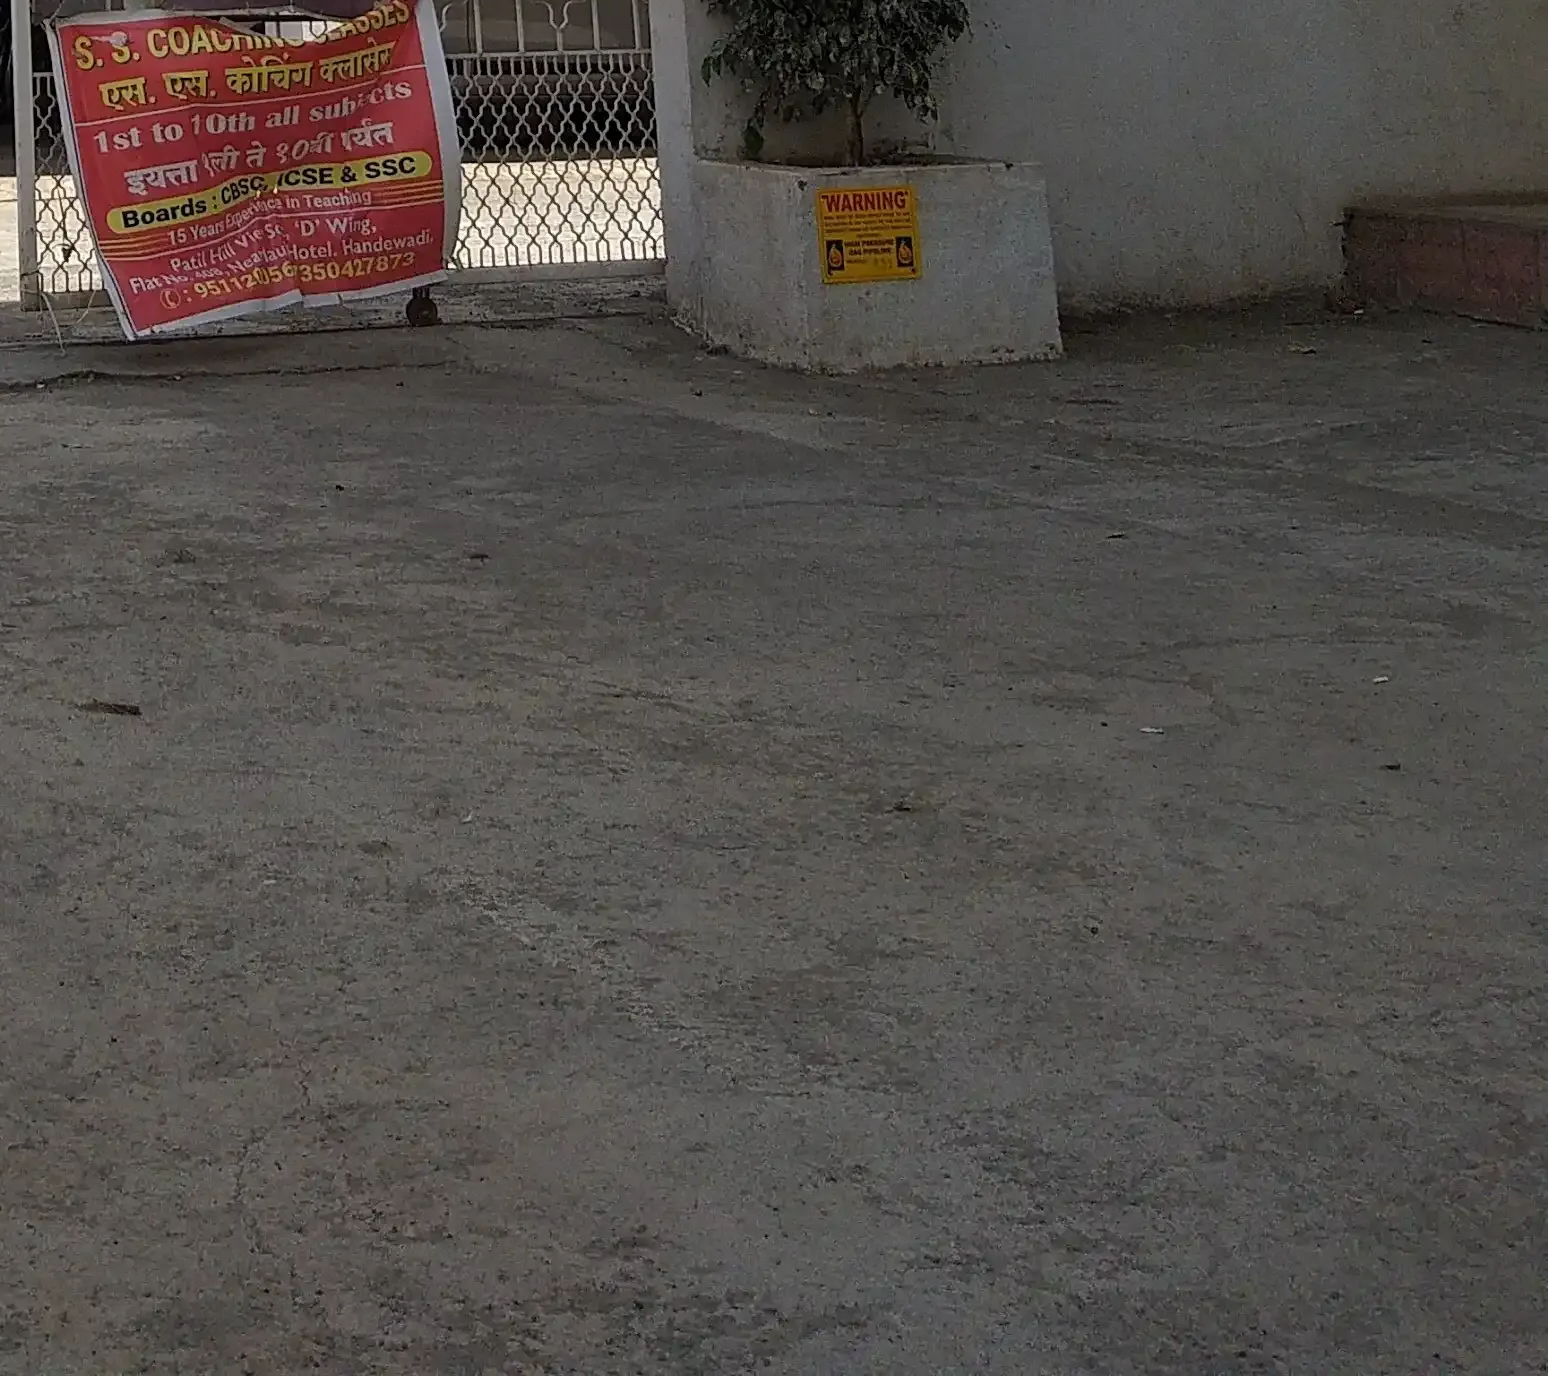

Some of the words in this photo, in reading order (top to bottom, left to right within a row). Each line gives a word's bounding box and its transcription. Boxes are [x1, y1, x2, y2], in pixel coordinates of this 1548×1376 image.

[73, 34, 104, 70] S.
[98, 76, 157, 111] एस.
[162, 69, 217, 100] एस.
[224, 51, 314, 95] कोचिंग
[93, 127, 144, 153] 1st
[152, 121, 184, 143] to
[190, 111, 256, 135] 10th
[265, 106, 300, 128] all
[121, 198, 207, 229] Boards
[278, 167, 334, 187] ICSE
[340, 166, 357, 183] &
[364, 156, 416, 179] SSC
[123, 159, 198, 196] इयत्ता
[245, 140, 267, 169] ते
[167, 230, 187, 246] 15
[305, 189, 373, 209] Teaching
[170, 249, 207, 273] Patil
[210, 241, 237, 264] Hill
[325, 217, 378, 237] Wing,
[128, 273, 162, 295] Flat
